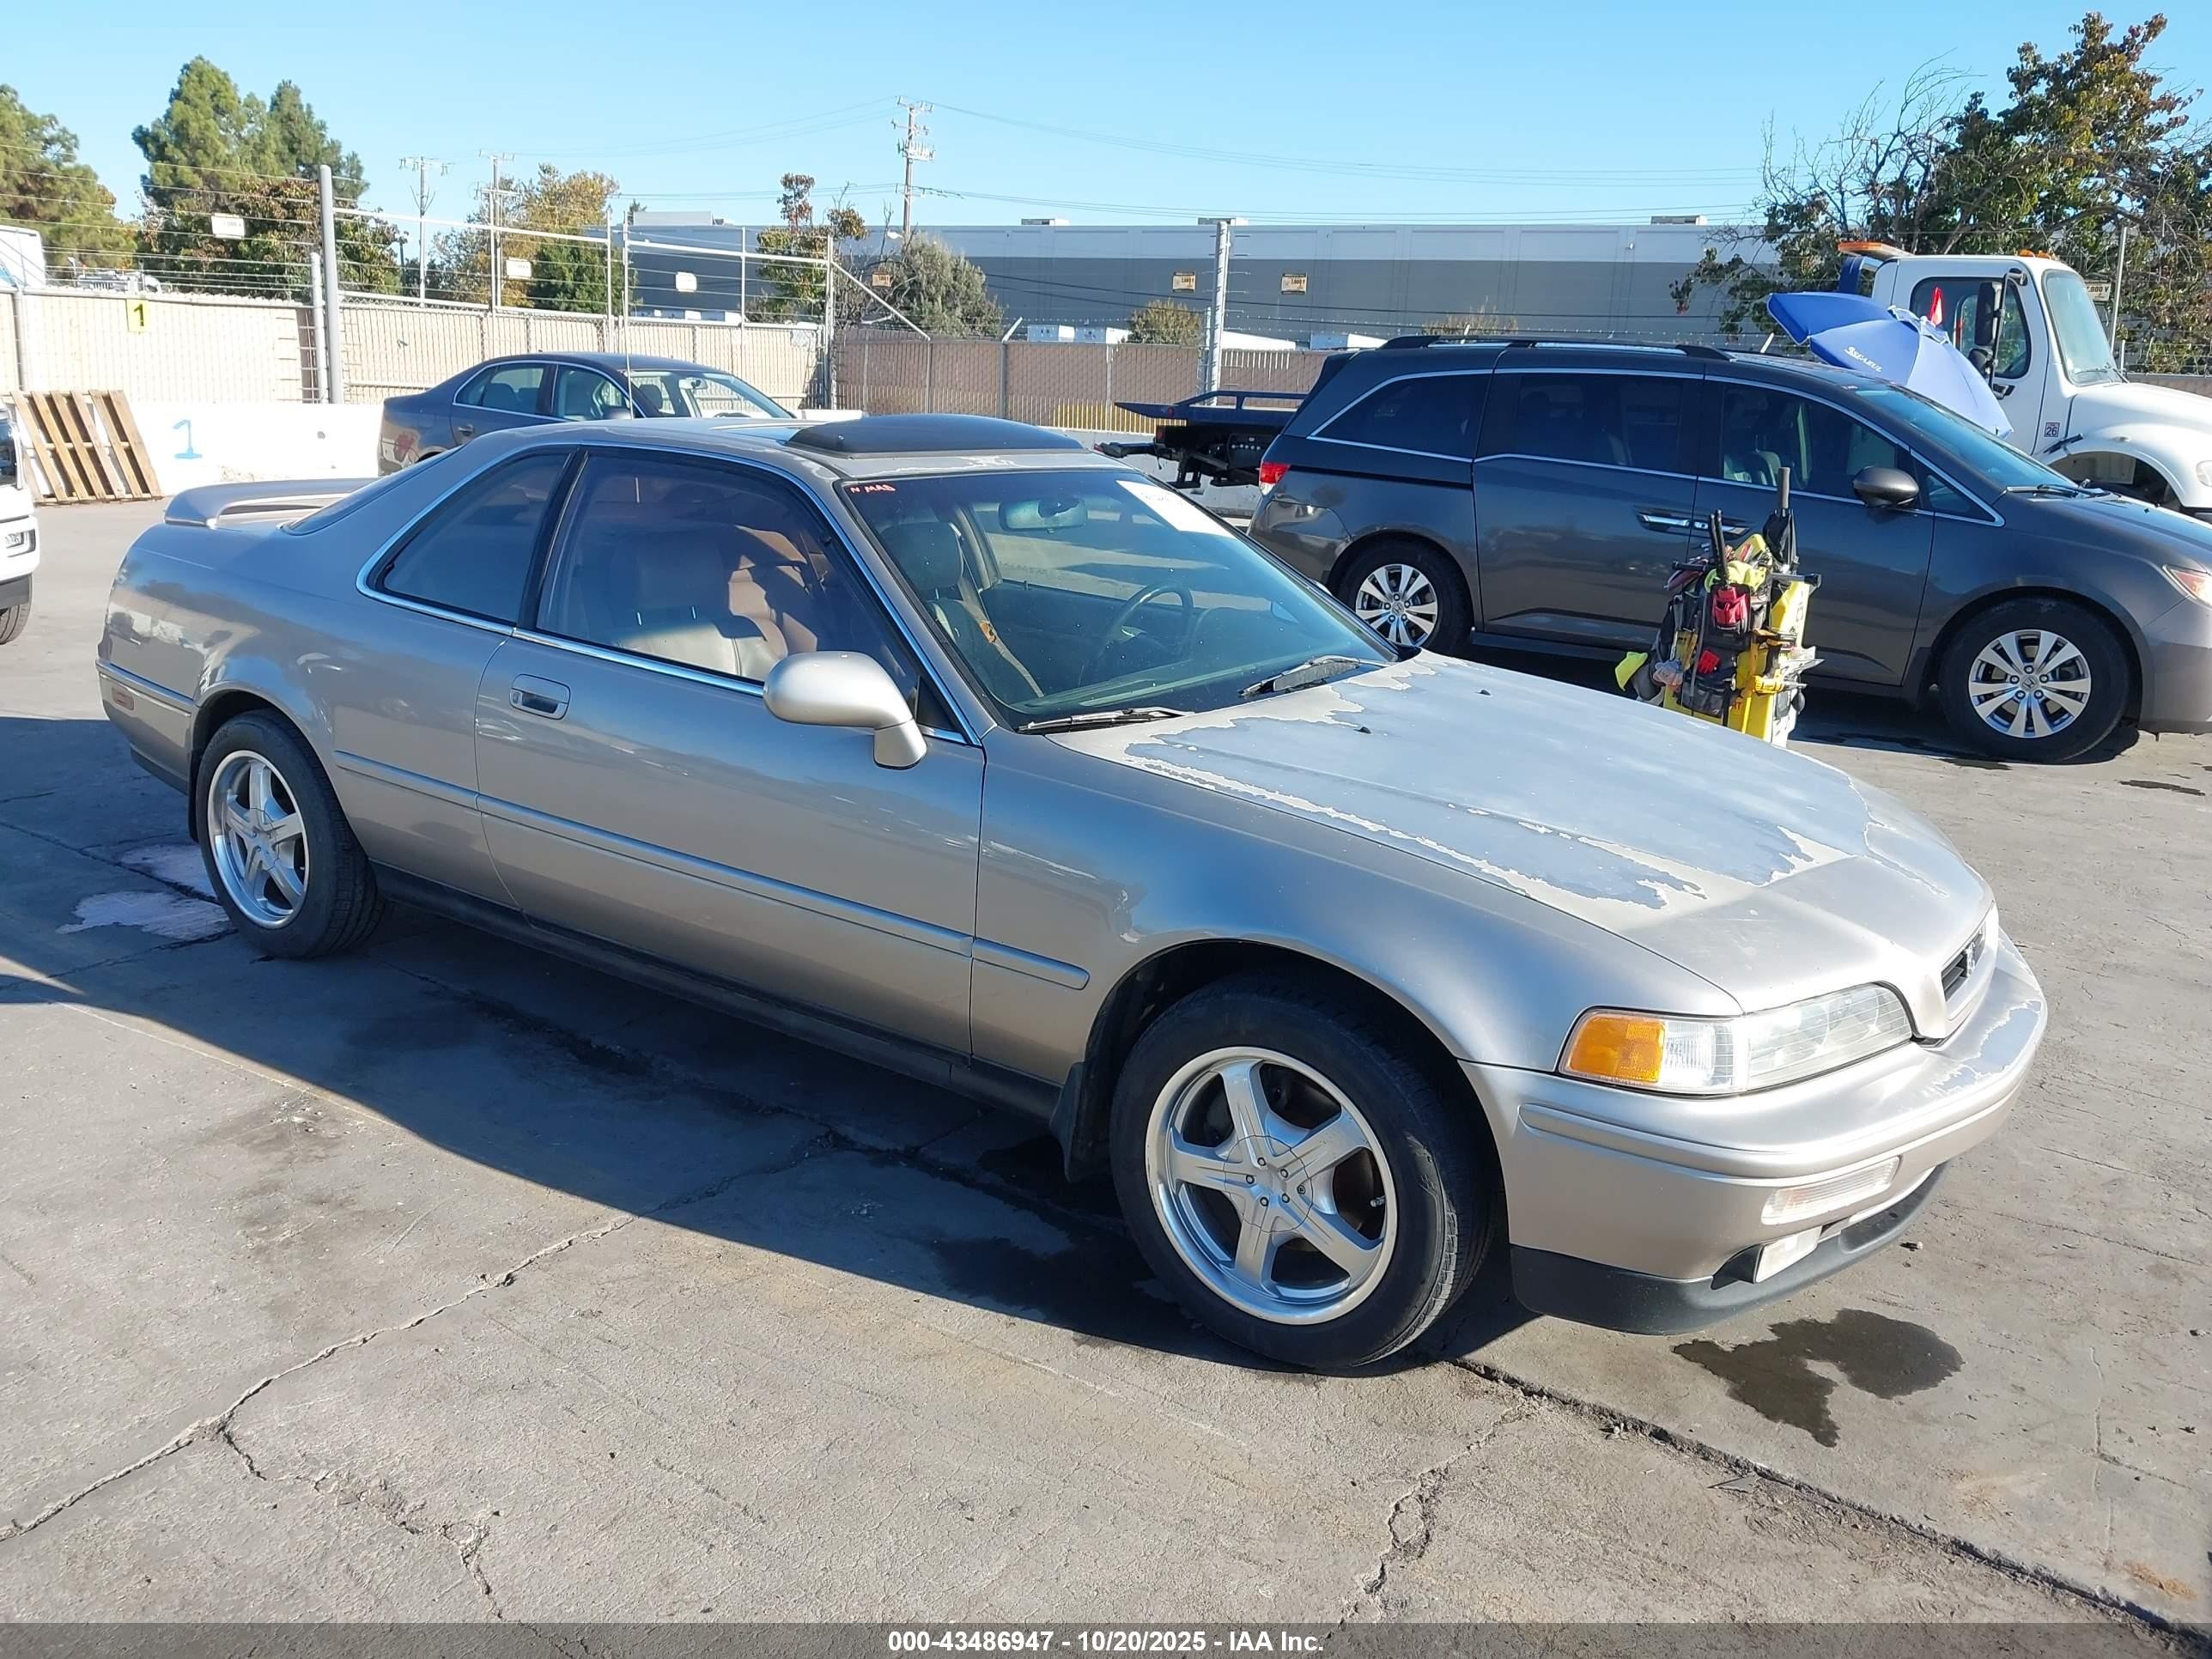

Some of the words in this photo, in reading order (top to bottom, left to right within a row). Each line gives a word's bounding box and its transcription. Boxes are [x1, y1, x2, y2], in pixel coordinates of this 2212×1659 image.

[134, 303, 144, 326] 1
[173, 419, 203, 459] 1
[2046, 426, 2057, 436] 26
